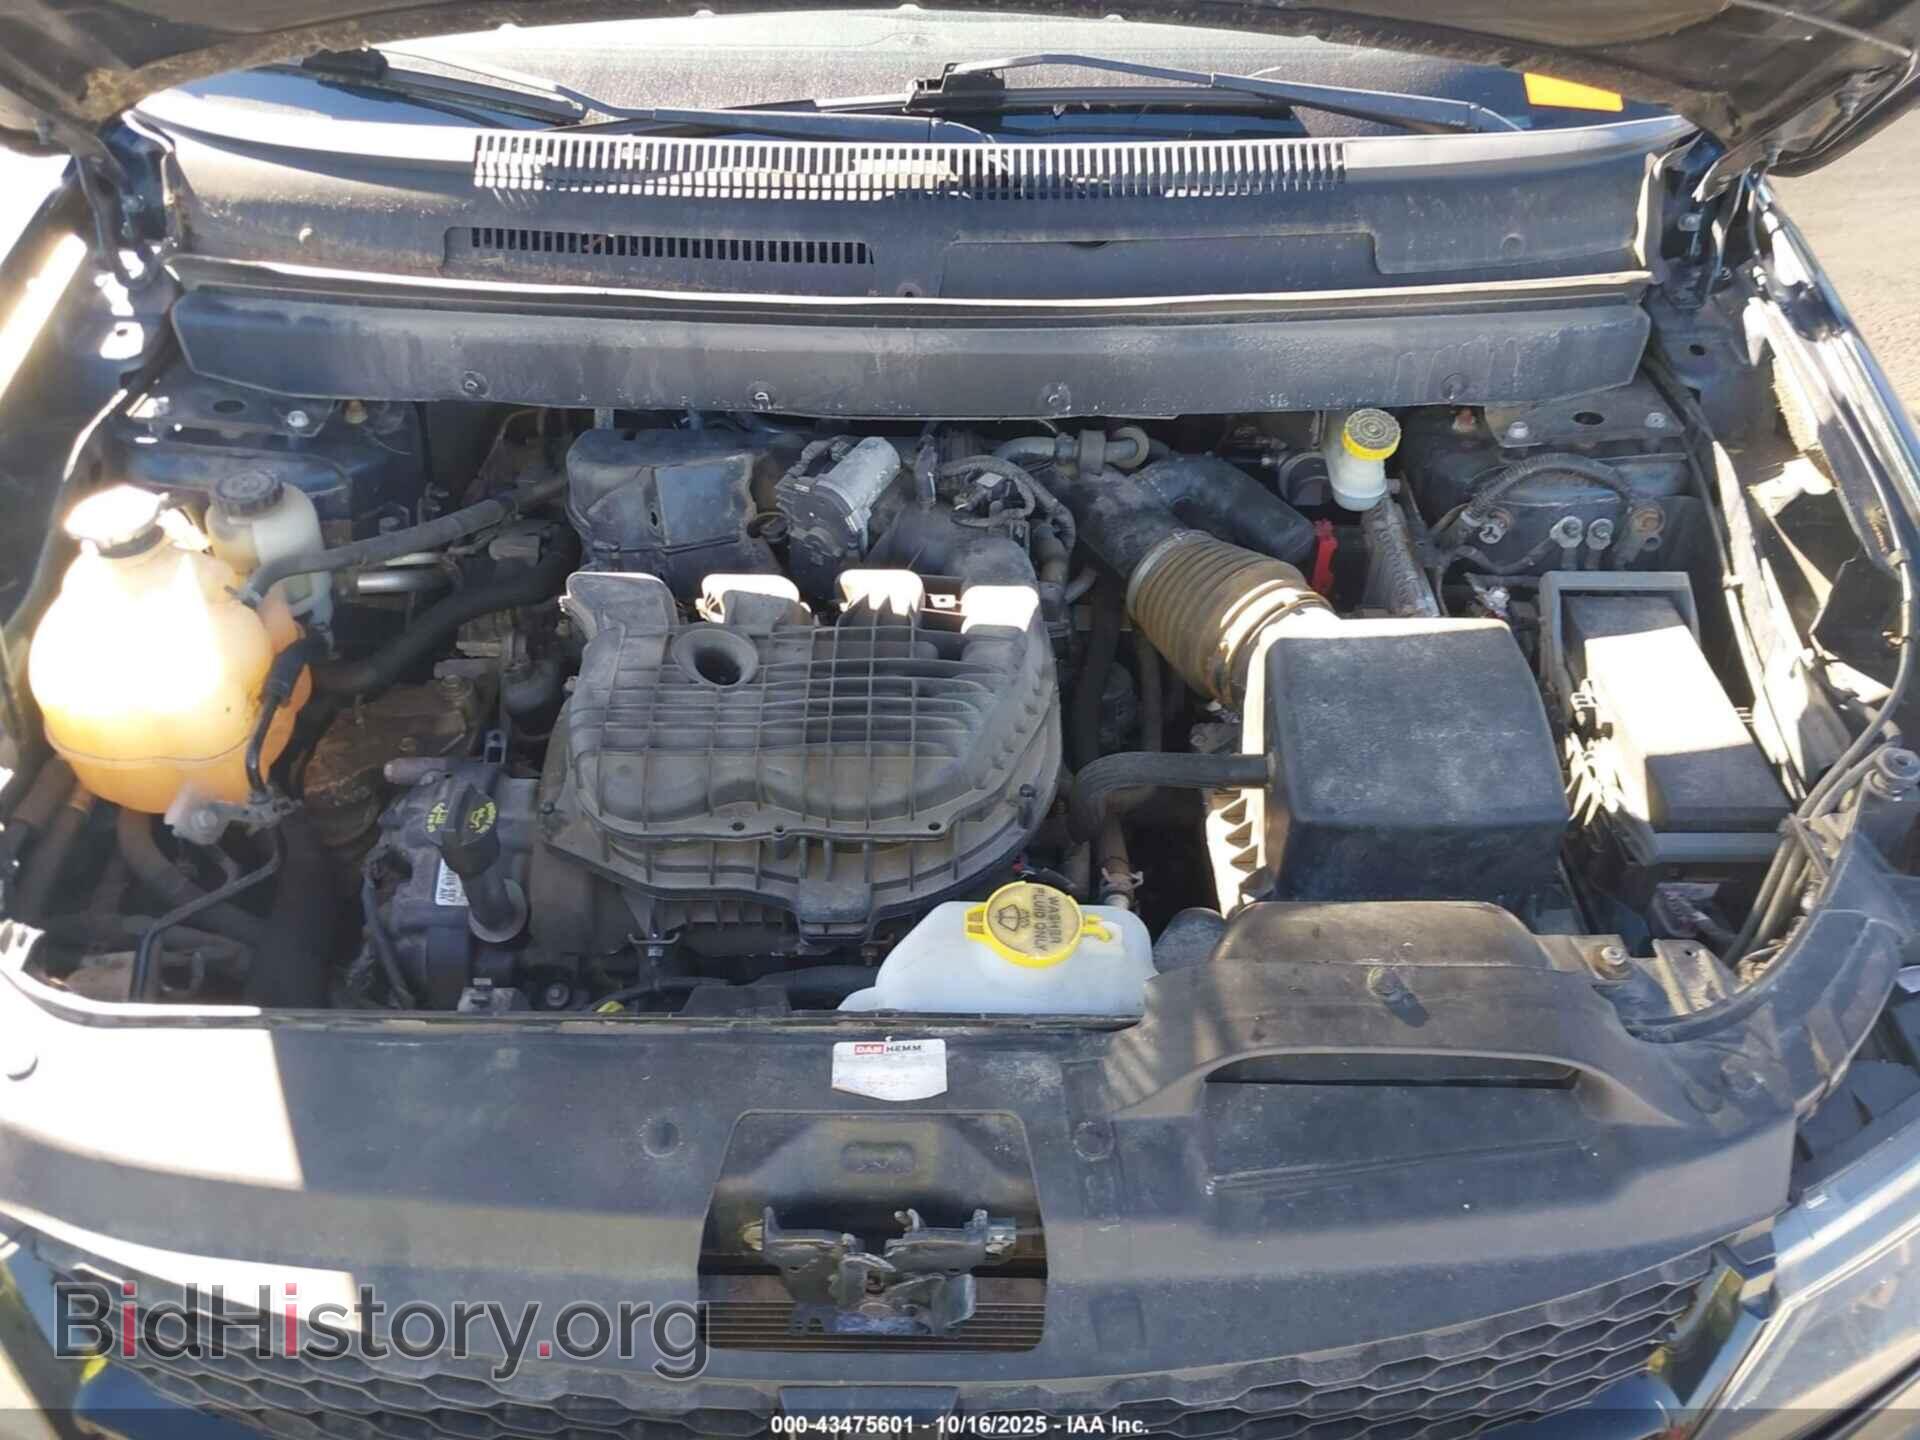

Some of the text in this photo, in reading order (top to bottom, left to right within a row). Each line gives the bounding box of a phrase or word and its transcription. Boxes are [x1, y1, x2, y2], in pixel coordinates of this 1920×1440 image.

[1032, 887, 1047, 951] FLUID ONLY
[1047, 895, 1063, 944] WASHER
